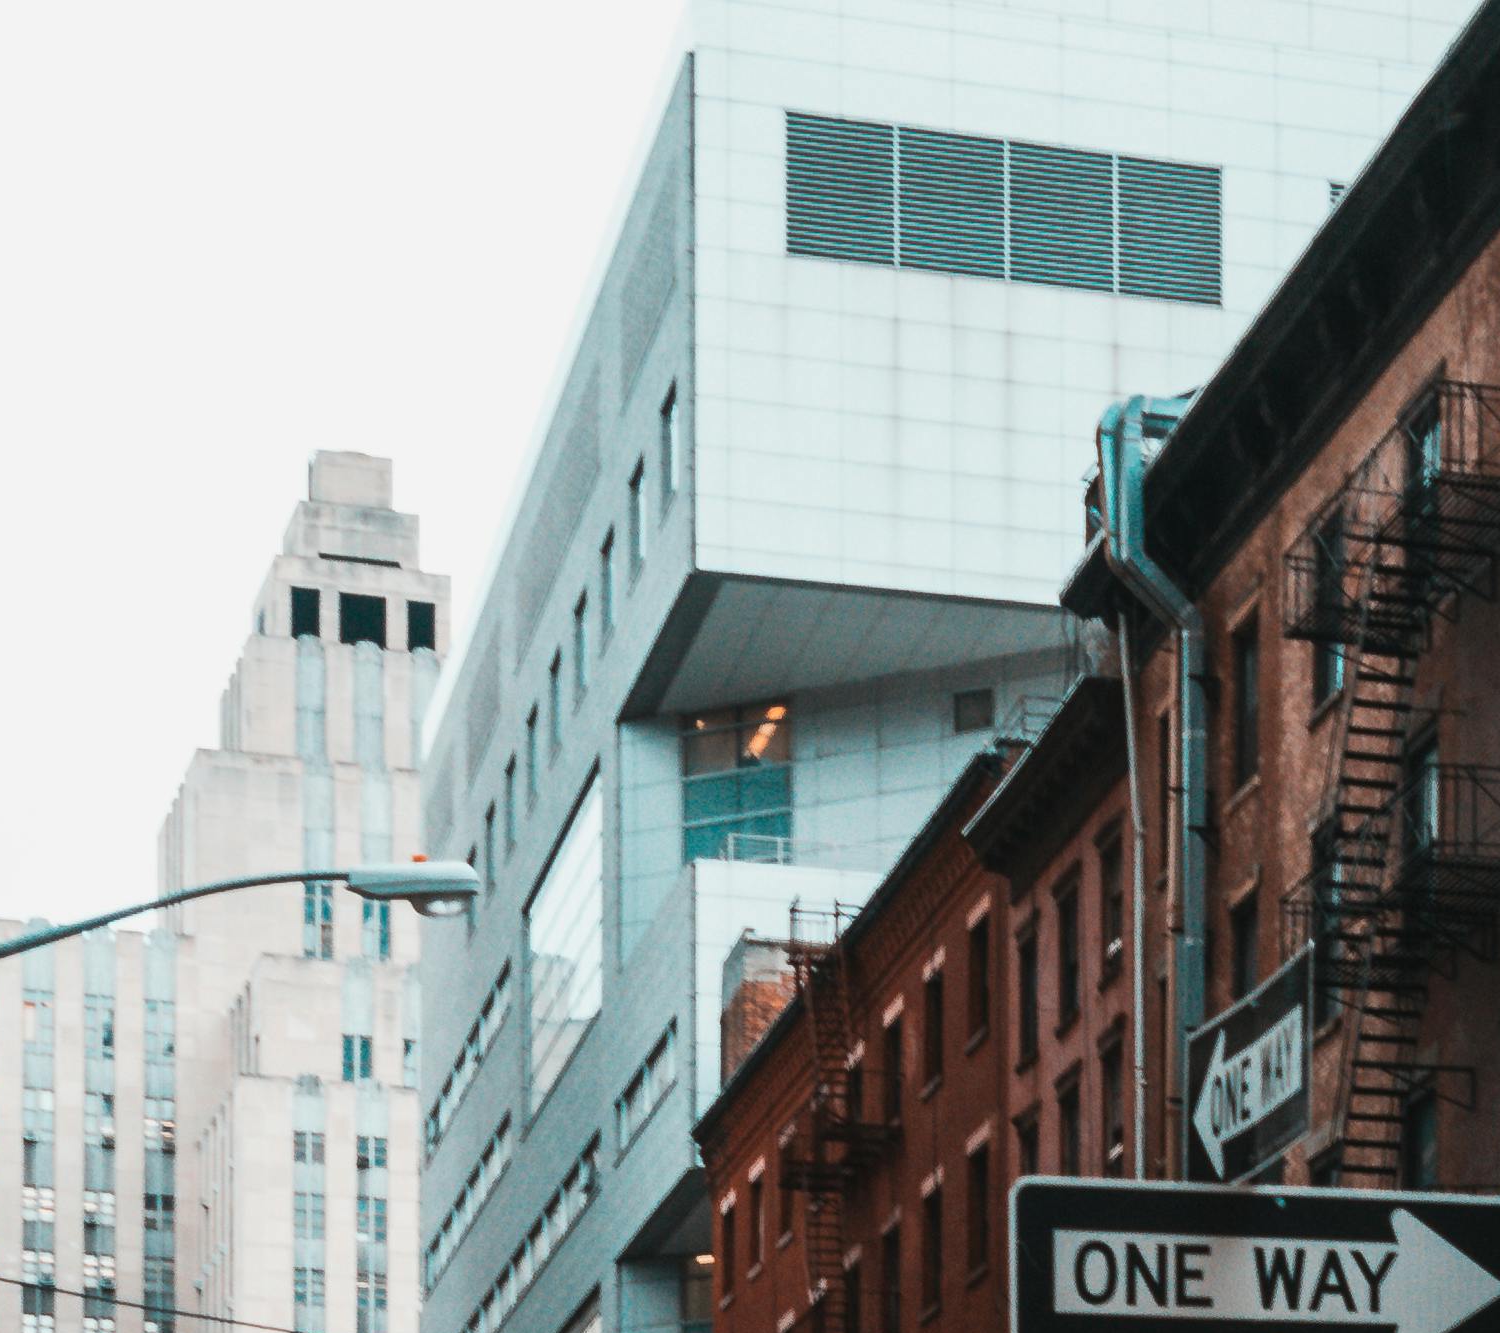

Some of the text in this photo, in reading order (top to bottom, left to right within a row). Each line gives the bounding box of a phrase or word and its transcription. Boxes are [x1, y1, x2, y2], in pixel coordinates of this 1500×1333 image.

[1211, 1019, 1299, 1137] ONE WAY
[1073, 1239, 1399, 1314] ONE WAY
